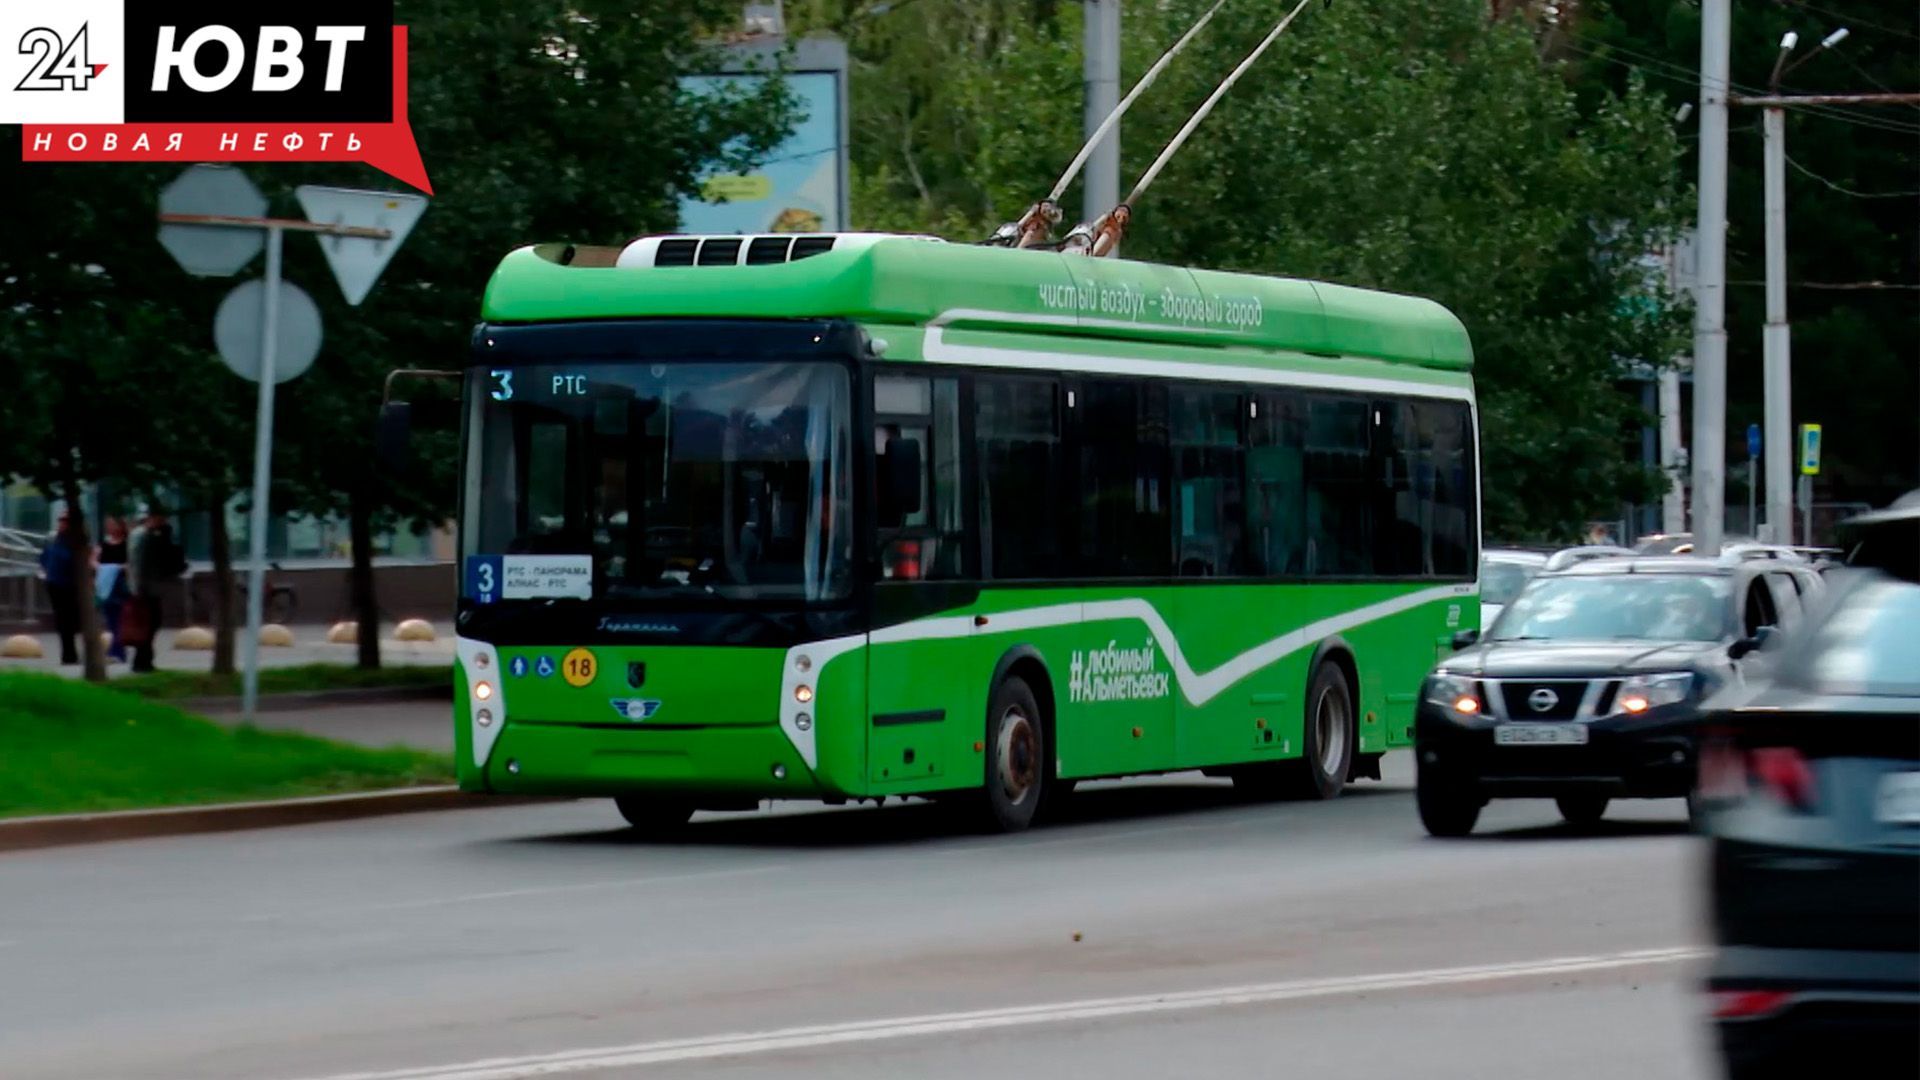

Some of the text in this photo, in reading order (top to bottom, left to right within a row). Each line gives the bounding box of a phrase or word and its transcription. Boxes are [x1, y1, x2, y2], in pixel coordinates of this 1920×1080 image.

[1100, 283, 1145, 323] воздух
[1160, 286, 1222, 327] здоровый
[1225, 296, 1262, 332] город
[491, 370, 586, 400] 3 РТС
[478, 562, 494, 592] 3
[570, 659, 591, 677] 18
[1083, 668, 1169, 702] Альметьевск
